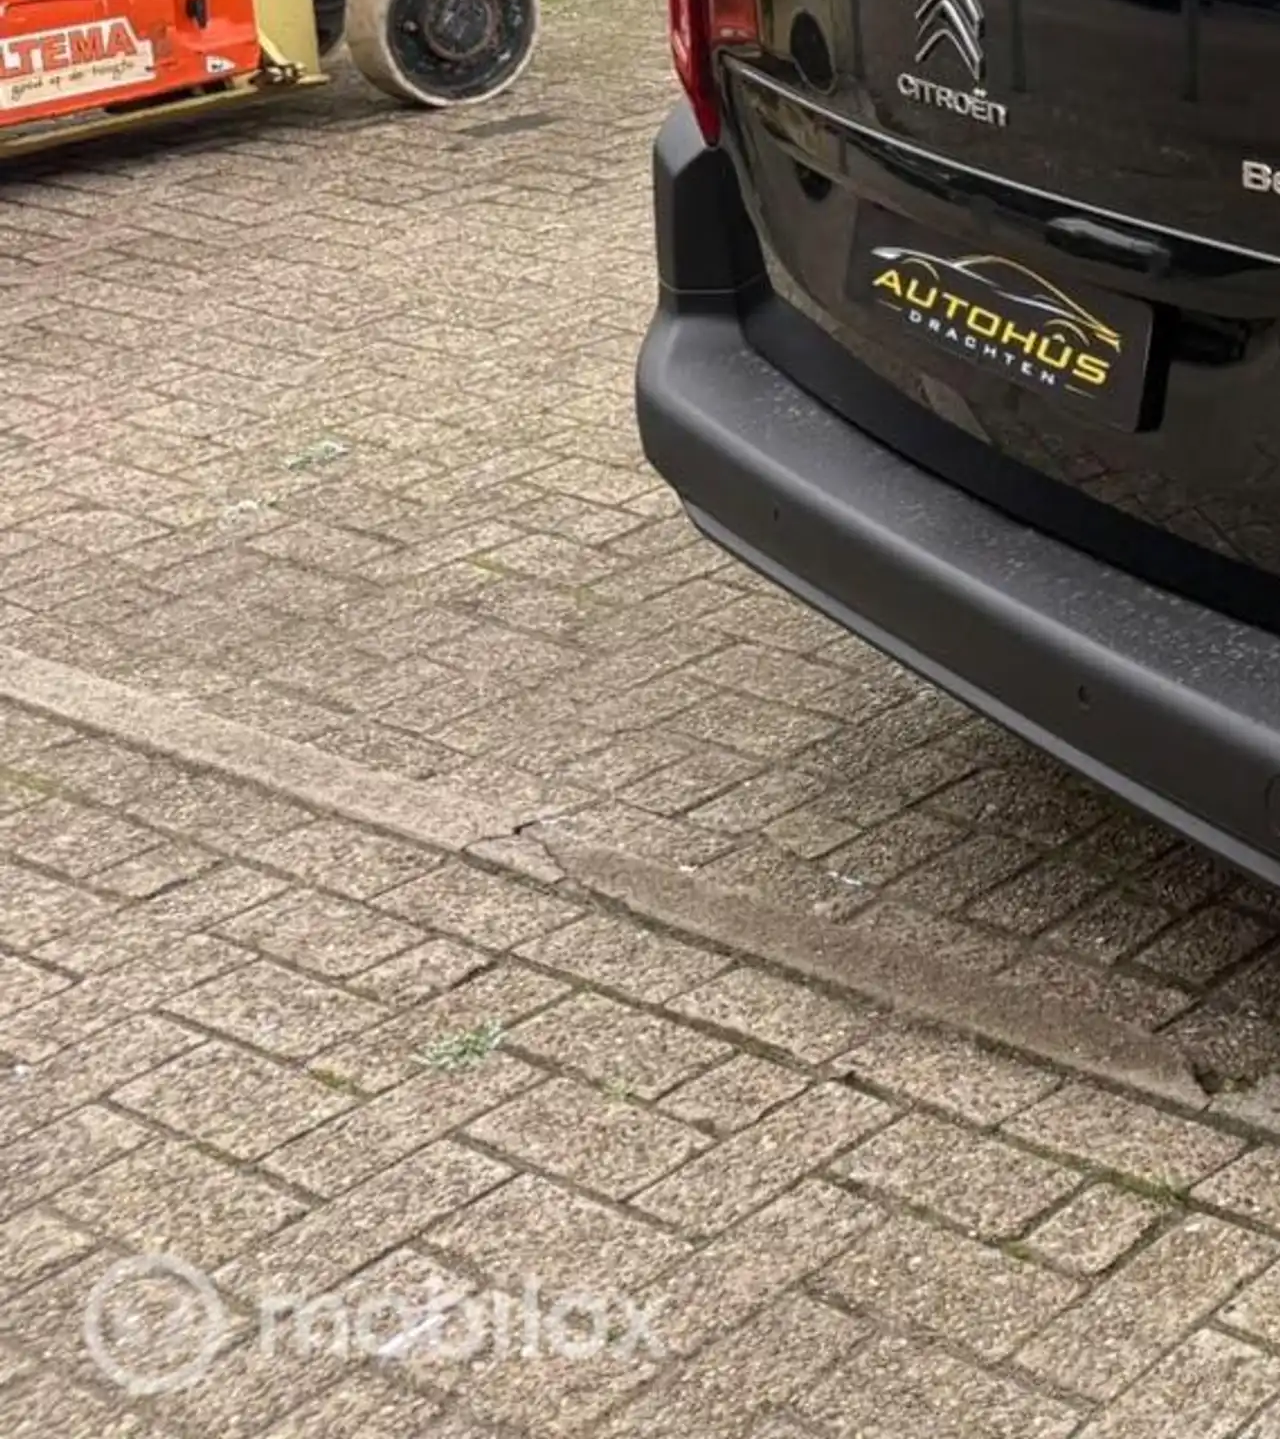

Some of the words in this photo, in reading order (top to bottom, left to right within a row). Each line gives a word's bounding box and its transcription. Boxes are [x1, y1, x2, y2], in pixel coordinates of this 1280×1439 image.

[897, 72, 1007, 128] CITROËN
[872, 268, 1111, 386] AUTOHÛS
[907, 310, 1057, 387] DRACHTEN
